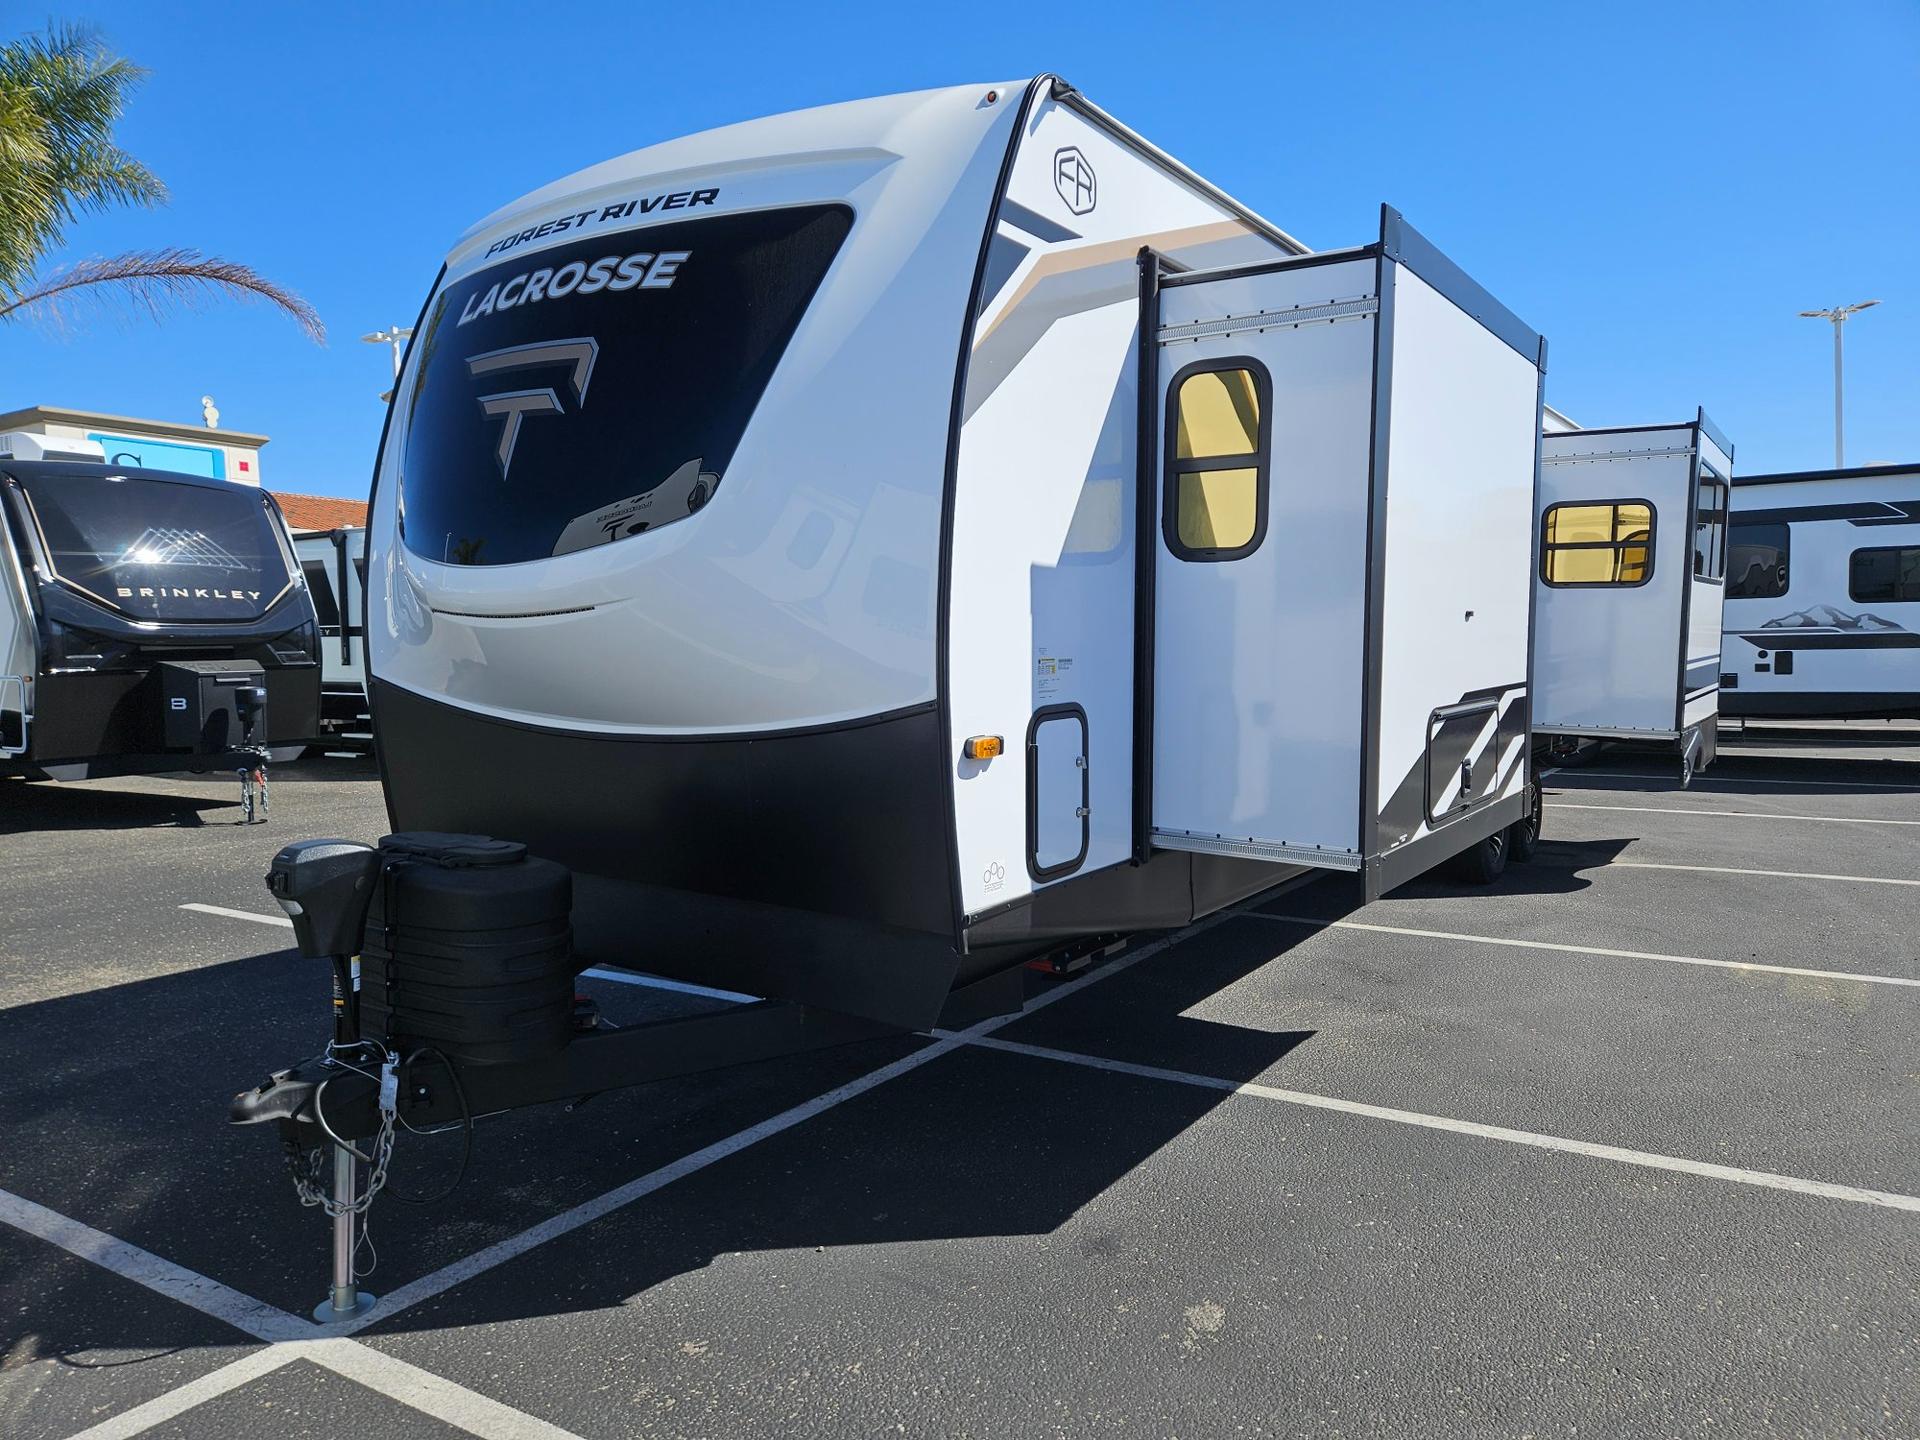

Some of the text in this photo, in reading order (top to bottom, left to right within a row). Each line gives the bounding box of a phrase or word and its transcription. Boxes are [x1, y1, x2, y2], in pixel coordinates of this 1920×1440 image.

[484, 187, 720, 259] FOREST RIVER
[456, 250, 693, 329] LACROSSE
[117, 587, 261, 600] BRINKLEY
[170, 697, 187, 710] B
